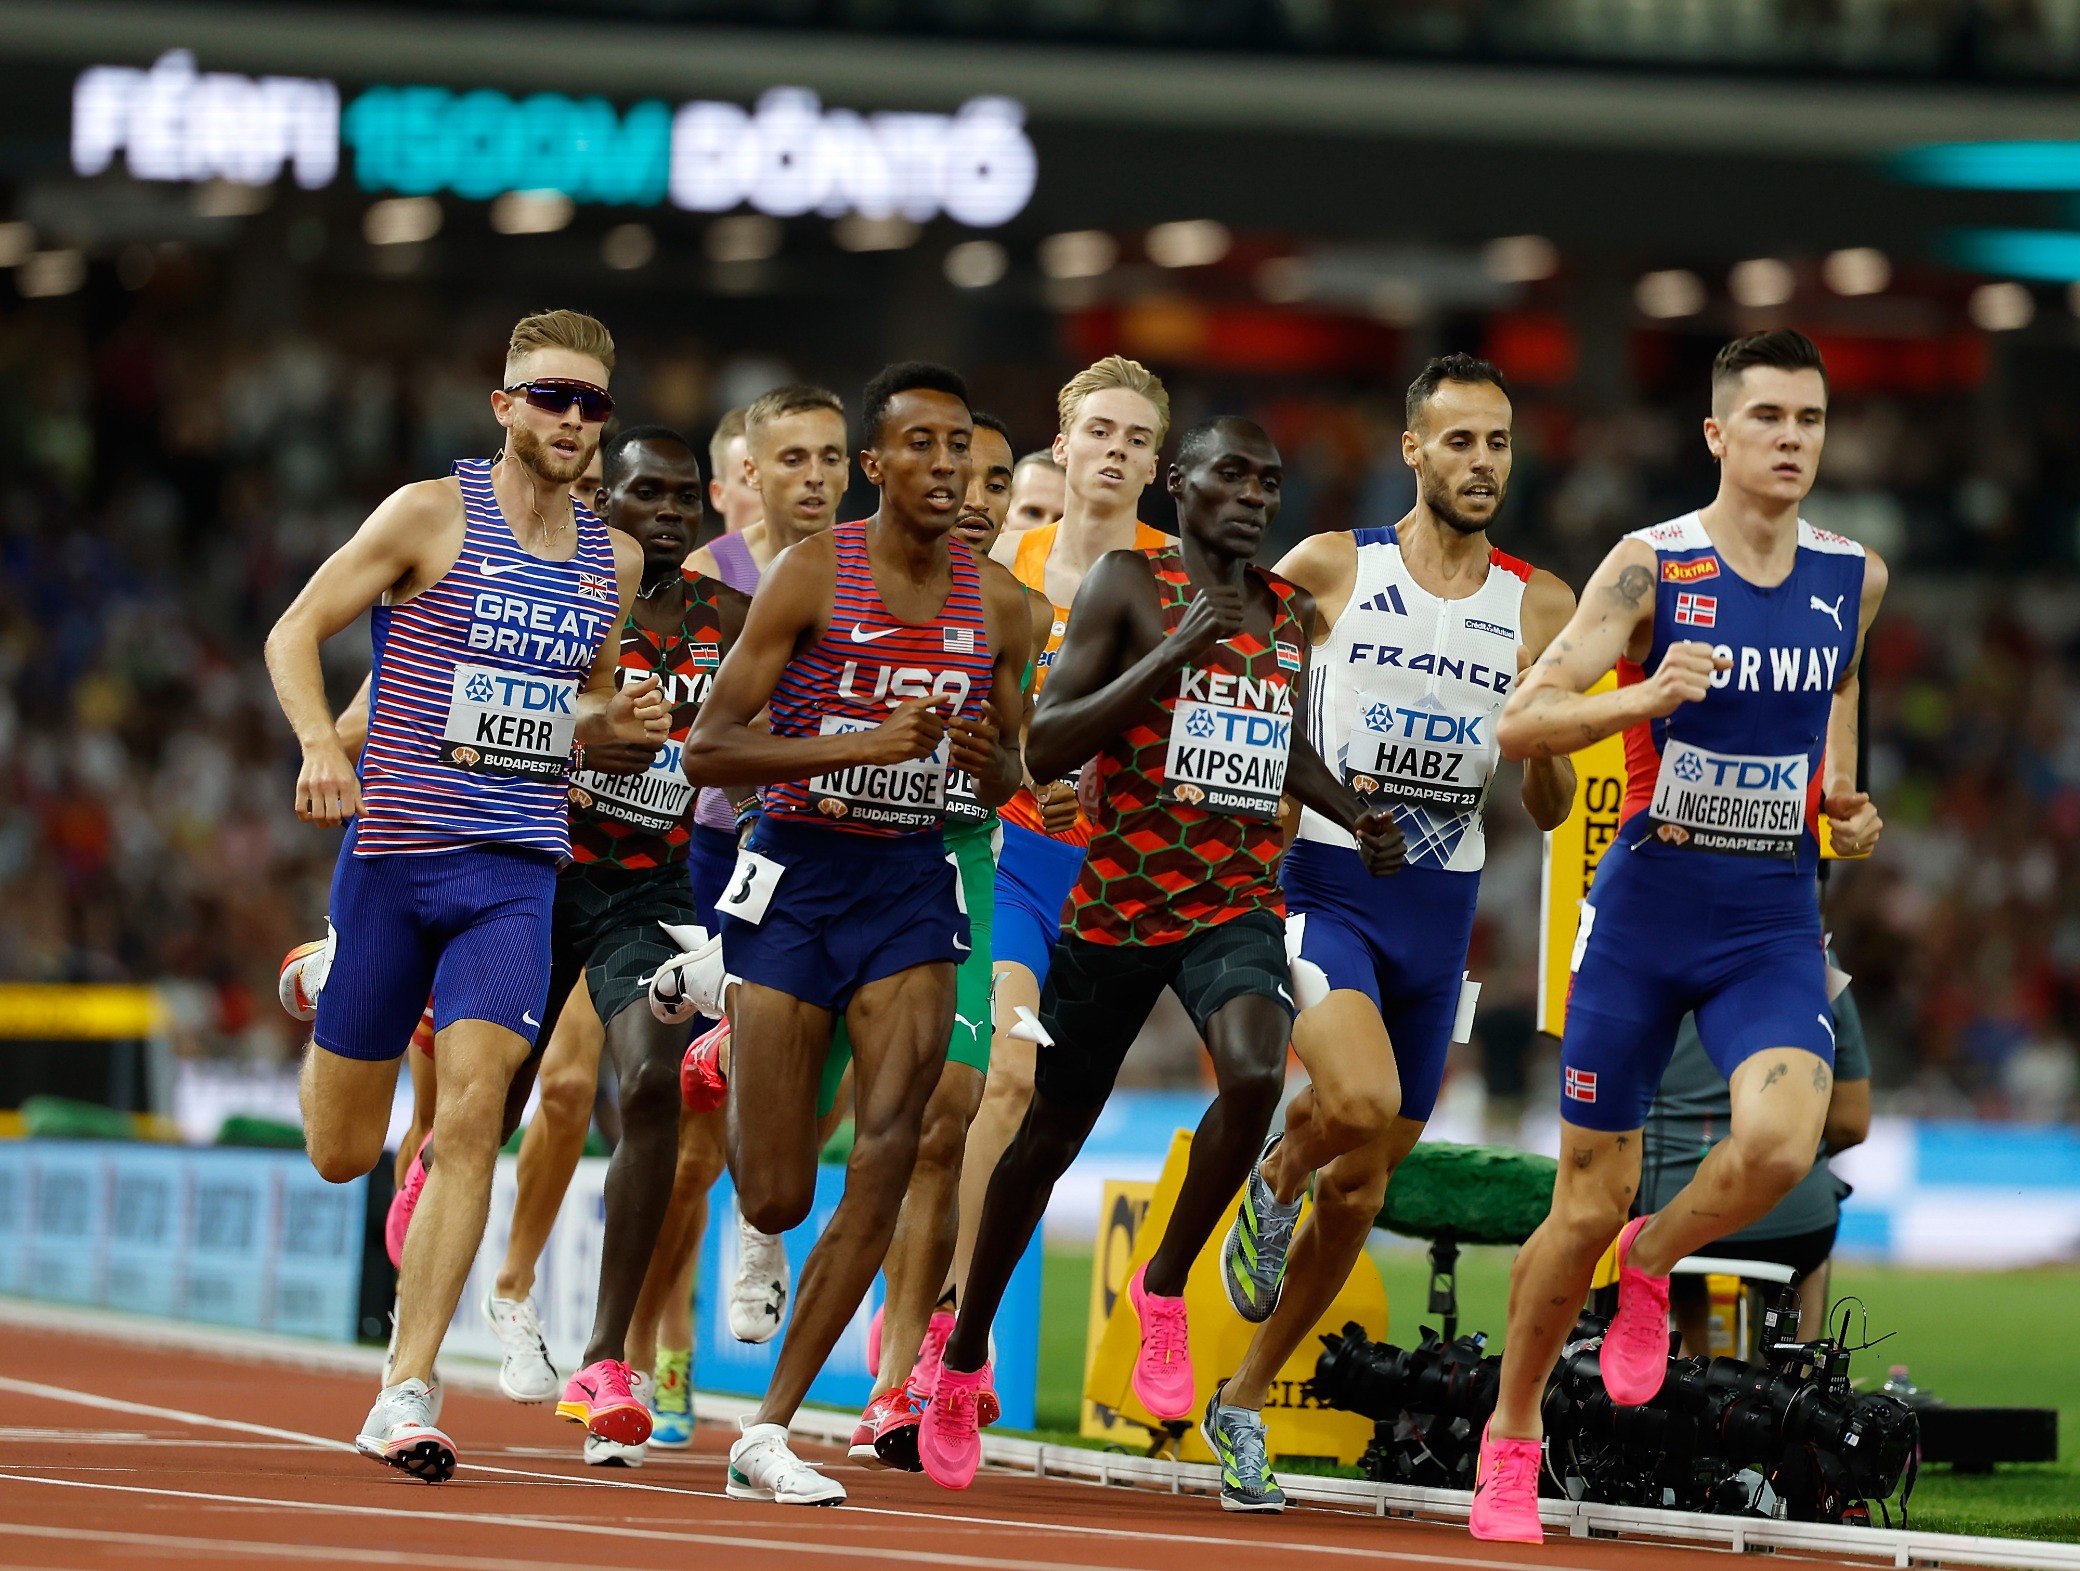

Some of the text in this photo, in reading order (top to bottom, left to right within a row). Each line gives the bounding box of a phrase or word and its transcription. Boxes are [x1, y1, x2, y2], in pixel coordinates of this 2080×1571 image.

[474, 593, 600, 640] GREAT
[467, 623, 594, 667] BRITAIN
[614, 666, 713, 704] ENYA
[838, 661, 971, 716] USA
[1349, 643, 1512, 695] FRANCE
[1709, 644, 1839, 692] ORWAY
[495, 676, 572, 714] TDK
[1179, 667, 1294, 717] KENYA
[476, 713, 553, 751] KERR
[1216, 712, 1290, 750] TDK
[1396, 707, 1483, 745] TDK
[649, 743, 683, 773] DK
[1175, 746, 1284, 791] KIPSANG
[1374, 742, 1464, 783] HABZ
[1706, 758, 1799, 790] TDK
[592, 771, 690, 812] CHERUIYOT
[821, 766, 938, 804] NUGUSE
[946, 801, 981, 817] APEST
[1656, 785, 1800, 830] J. INGEBRIGTSEN
[729, 863, 757, 904] 3
